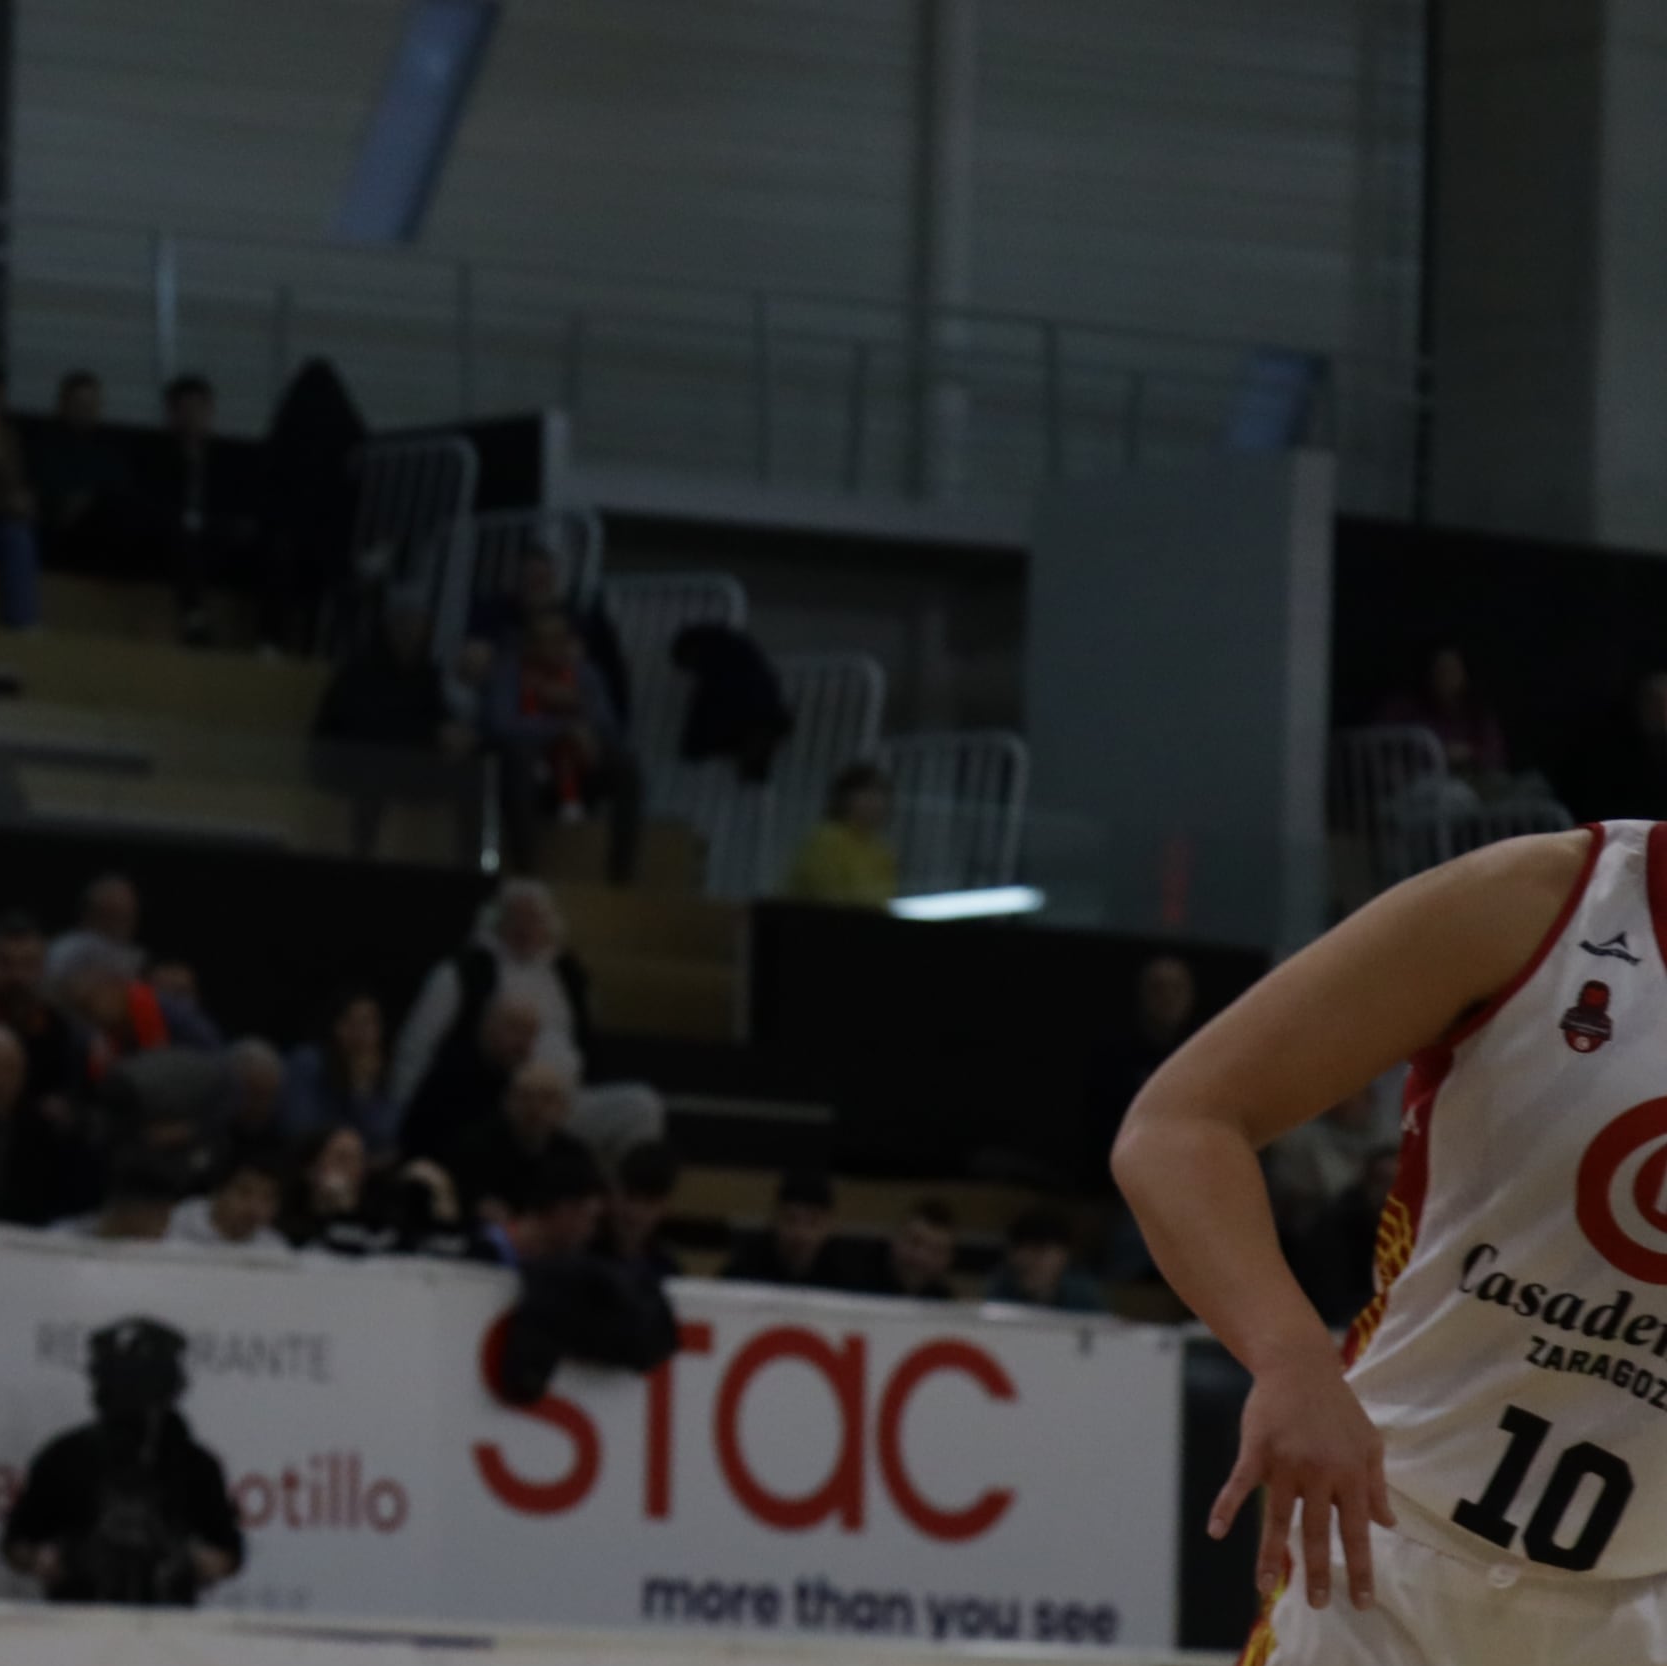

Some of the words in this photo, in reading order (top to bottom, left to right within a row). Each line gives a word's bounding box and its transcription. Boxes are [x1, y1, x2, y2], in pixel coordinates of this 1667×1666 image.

[1458, 1243, 1667, 1362] Casade
[34, 1322, 335, 1384] RERANTE
[1526, 1336, 1667, 1413] ZARAGOZ
[233, 1450, 409, 1534] otillo
[1452, 1404, 1635, 1572] 10
[641, 1574, 779, 1624] more
[793, 1574, 915, 1630] than
[929, 1590, 1021, 1642] you
[1037, 1600, 1122, 1644] see
